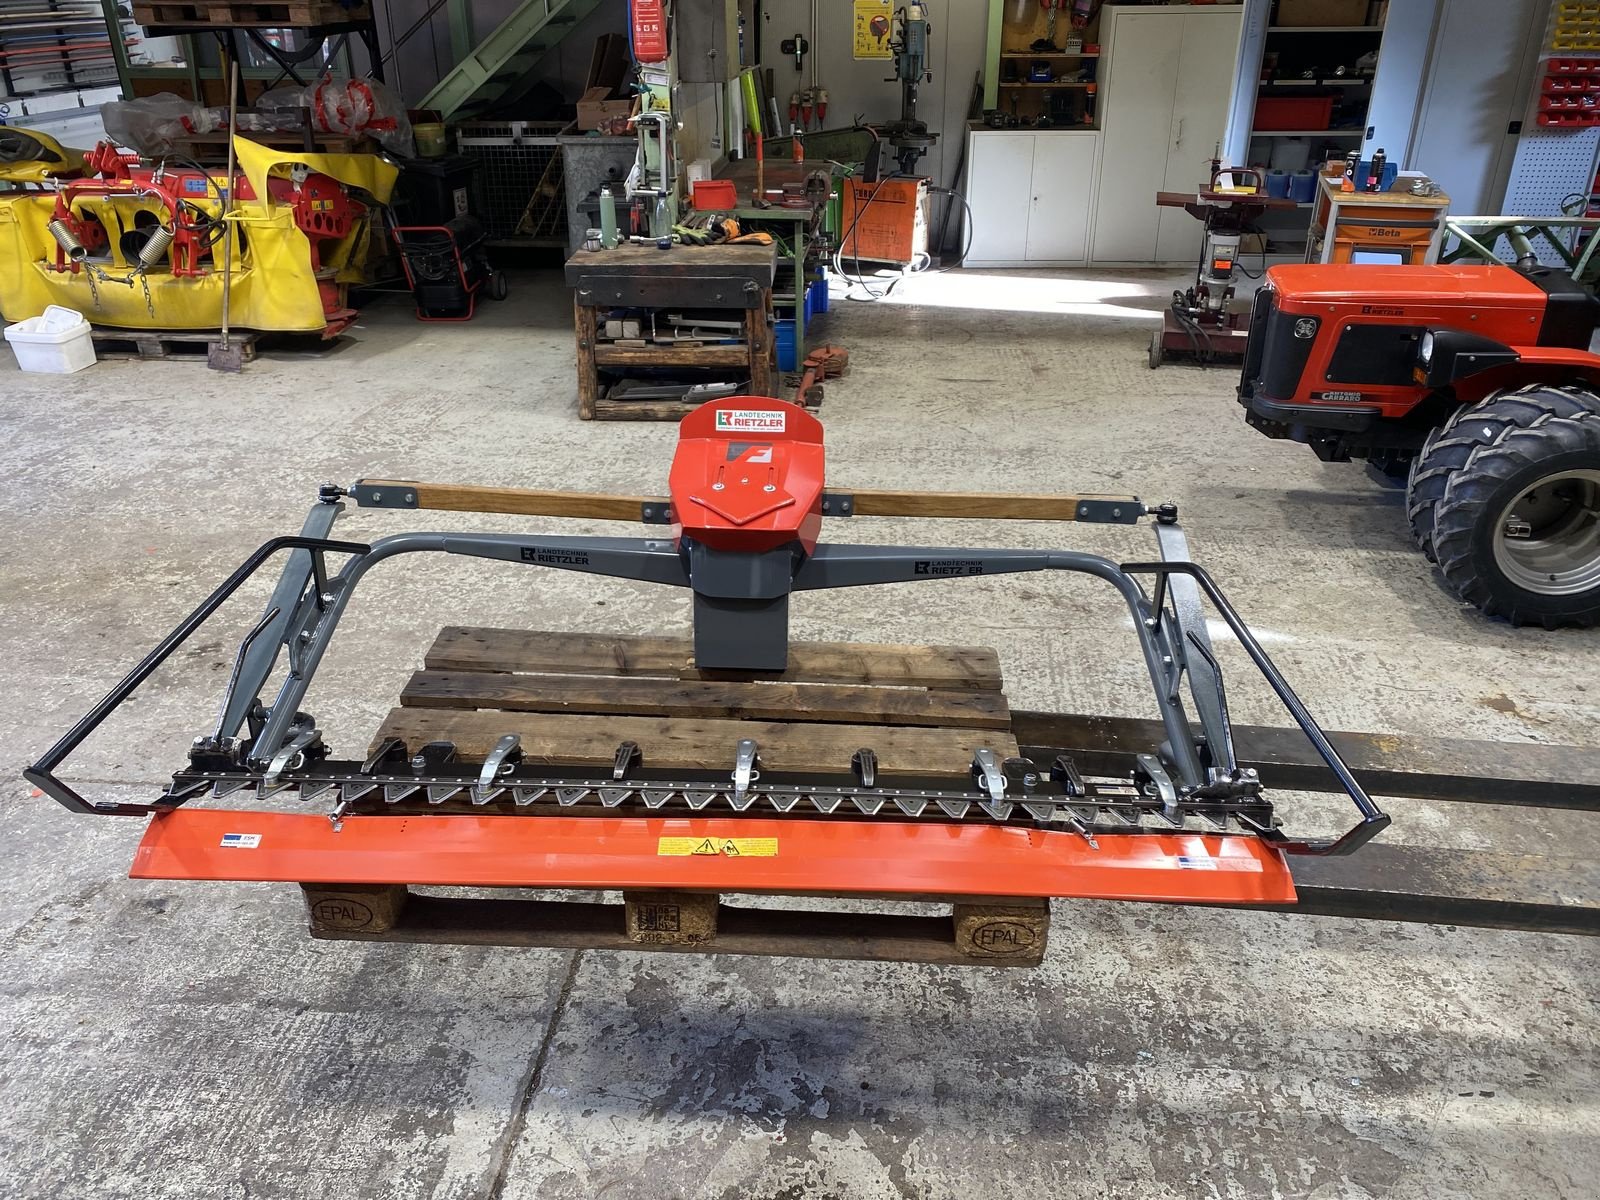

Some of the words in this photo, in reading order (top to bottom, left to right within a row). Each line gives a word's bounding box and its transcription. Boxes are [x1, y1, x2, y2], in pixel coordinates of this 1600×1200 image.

[1378, 228, 1400, 237] Beta
[734, 418, 783, 427] RIETZLER
[537, 548, 588, 557] LANDTECHNIK
[537, 554, 589, 565] RIETZLER
[320, 905, 362, 921] EPAL
[981, 929, 1022, 945] EPAL
